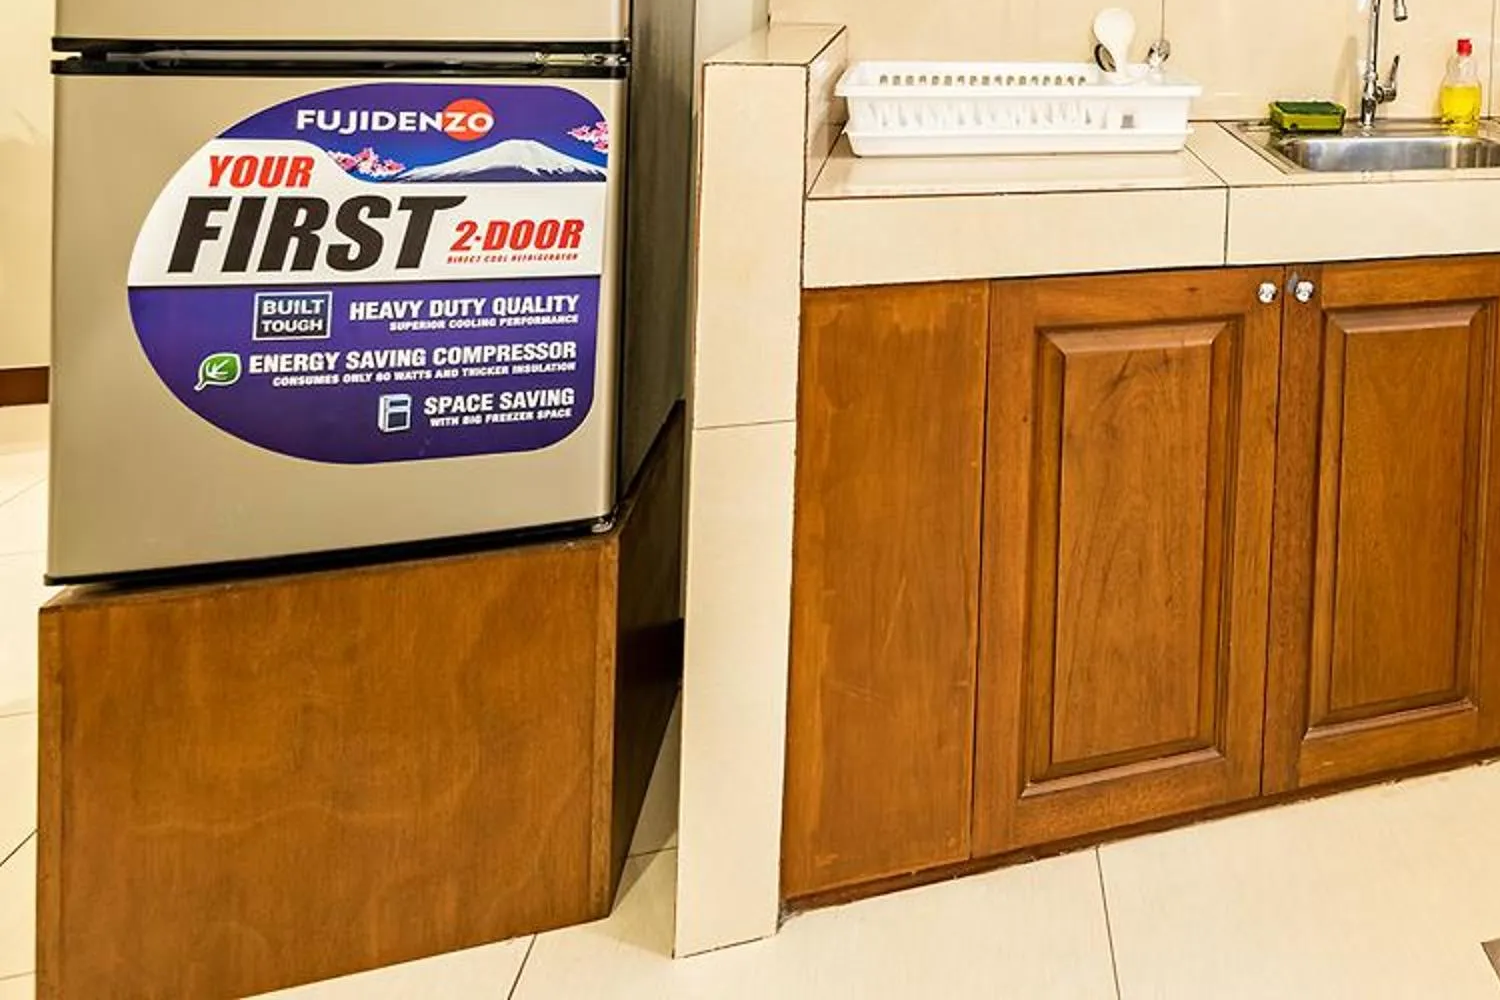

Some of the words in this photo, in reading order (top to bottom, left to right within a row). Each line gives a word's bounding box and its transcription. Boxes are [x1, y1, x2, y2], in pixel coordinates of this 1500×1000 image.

[296, 108, 495, 133] FUJIDENZO
[208, 154, 315, 188] YOUR
[166, 195, 467, 274] FIRST
[450, 219, 585, 251] 2-DOOR
[448, 255, 481, 264] DIRECT
[484, 255, 508, 263] COOL
[511, 253, 578, 262] REFRIGERATOR
[262, 299, 324, 315] BUILT
[350, 300, 424, 320] HEAVY
[429, 298, 487, 317] DUTY
[492, 295, 579, 316] QUALITY
[262, 319, 323, 333] TOUGH
[389, 320, 446, 331] SUPERIOR
[450, 318, 496, 328] COOLING
[500, 314, 579, 327] PERFORMANCE
[249, 351, 340, 374] ENERGY
[346, 348, 426, 370] SAVING
[433, 341, 577, 365] COMPRESSOR
[272, 374, 339, 387] CONSUMES
[343, 373, 373, 383] ONLY
[394, 369, 432, 381] WATTS
[435, 367, 459, 379] AND
[462, 365, 509, 377] THICKER
[512, 362, 575, 374] INSULATION
[424, 393, 494, 415] SPACE
[499, 387, 575, 410] SAVING
[430, 416, 459, 427] WITH
[462, 414, 483, 425] BIG
[485, 411, 534, 423] FREEZER
[536, 408, 572, 420] SPACE
